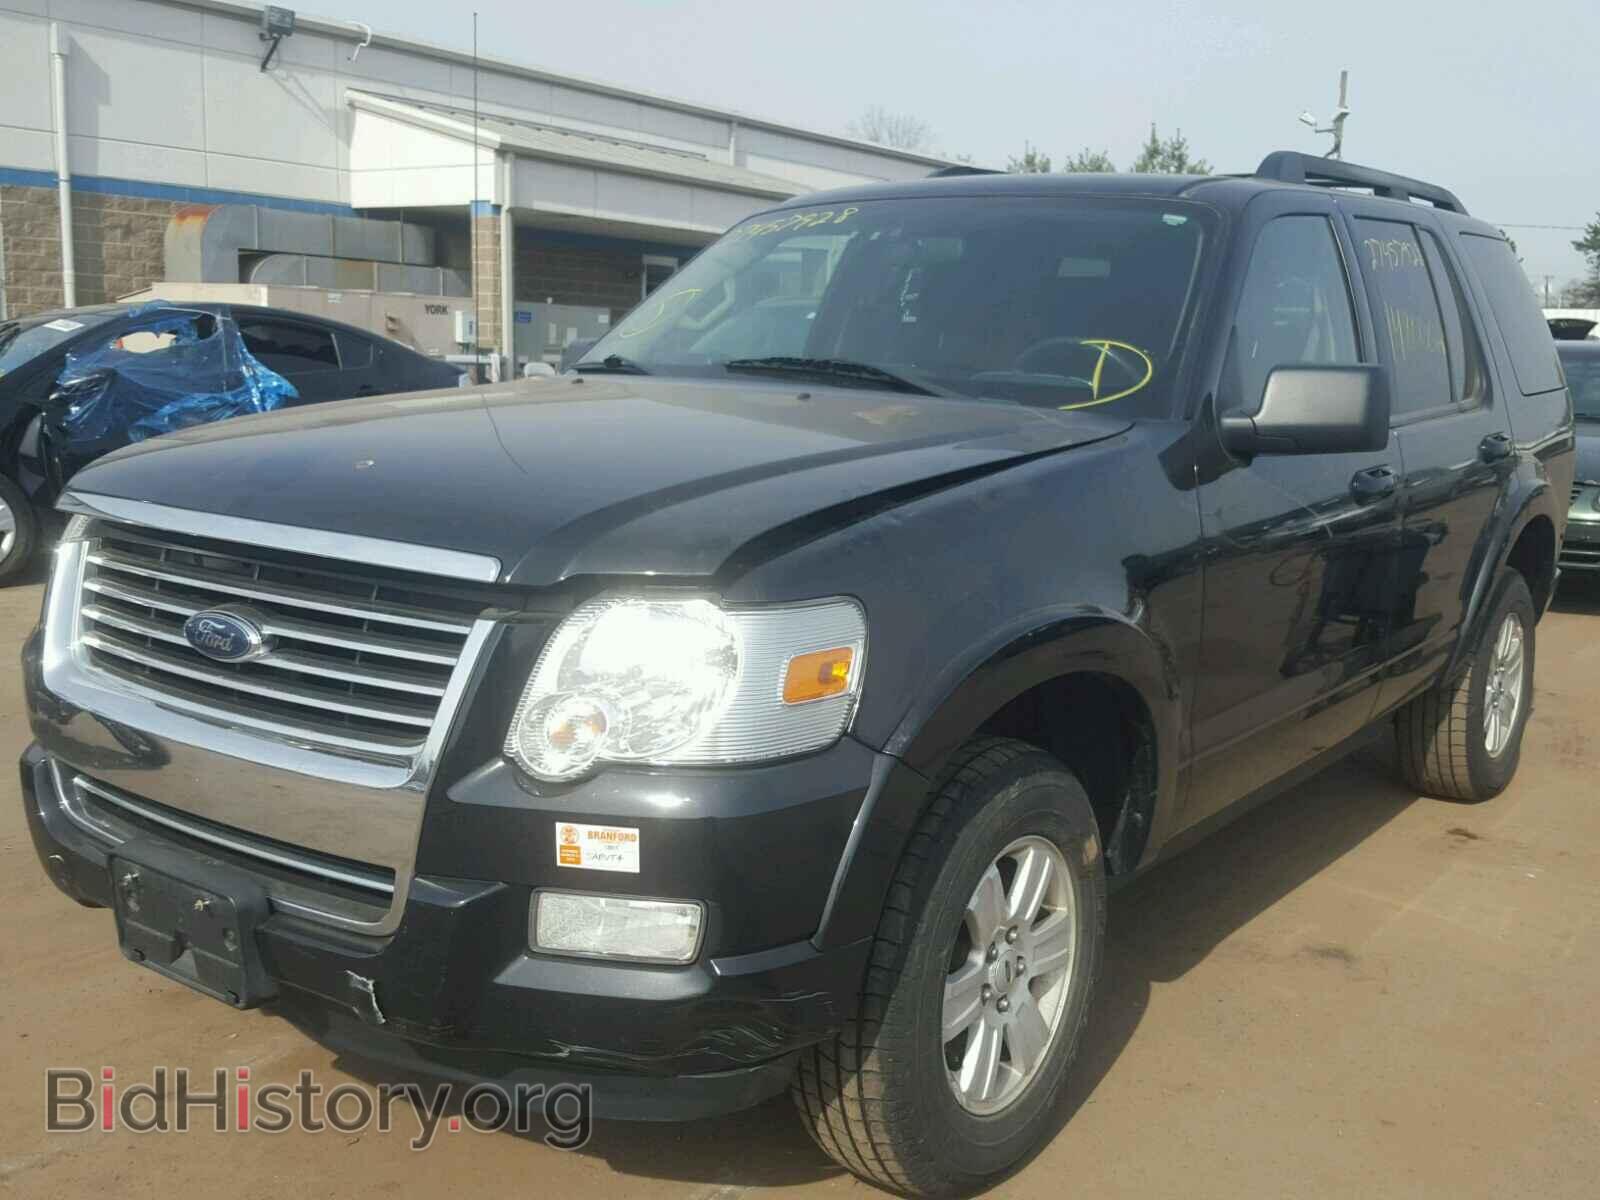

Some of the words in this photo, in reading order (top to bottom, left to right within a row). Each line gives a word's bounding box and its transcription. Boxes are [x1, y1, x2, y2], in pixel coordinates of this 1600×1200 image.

[424, 304, 448, 315] YORK
[196, 619, 235, 651] Ford
[586, 830, 637, 843] BRANFORD
